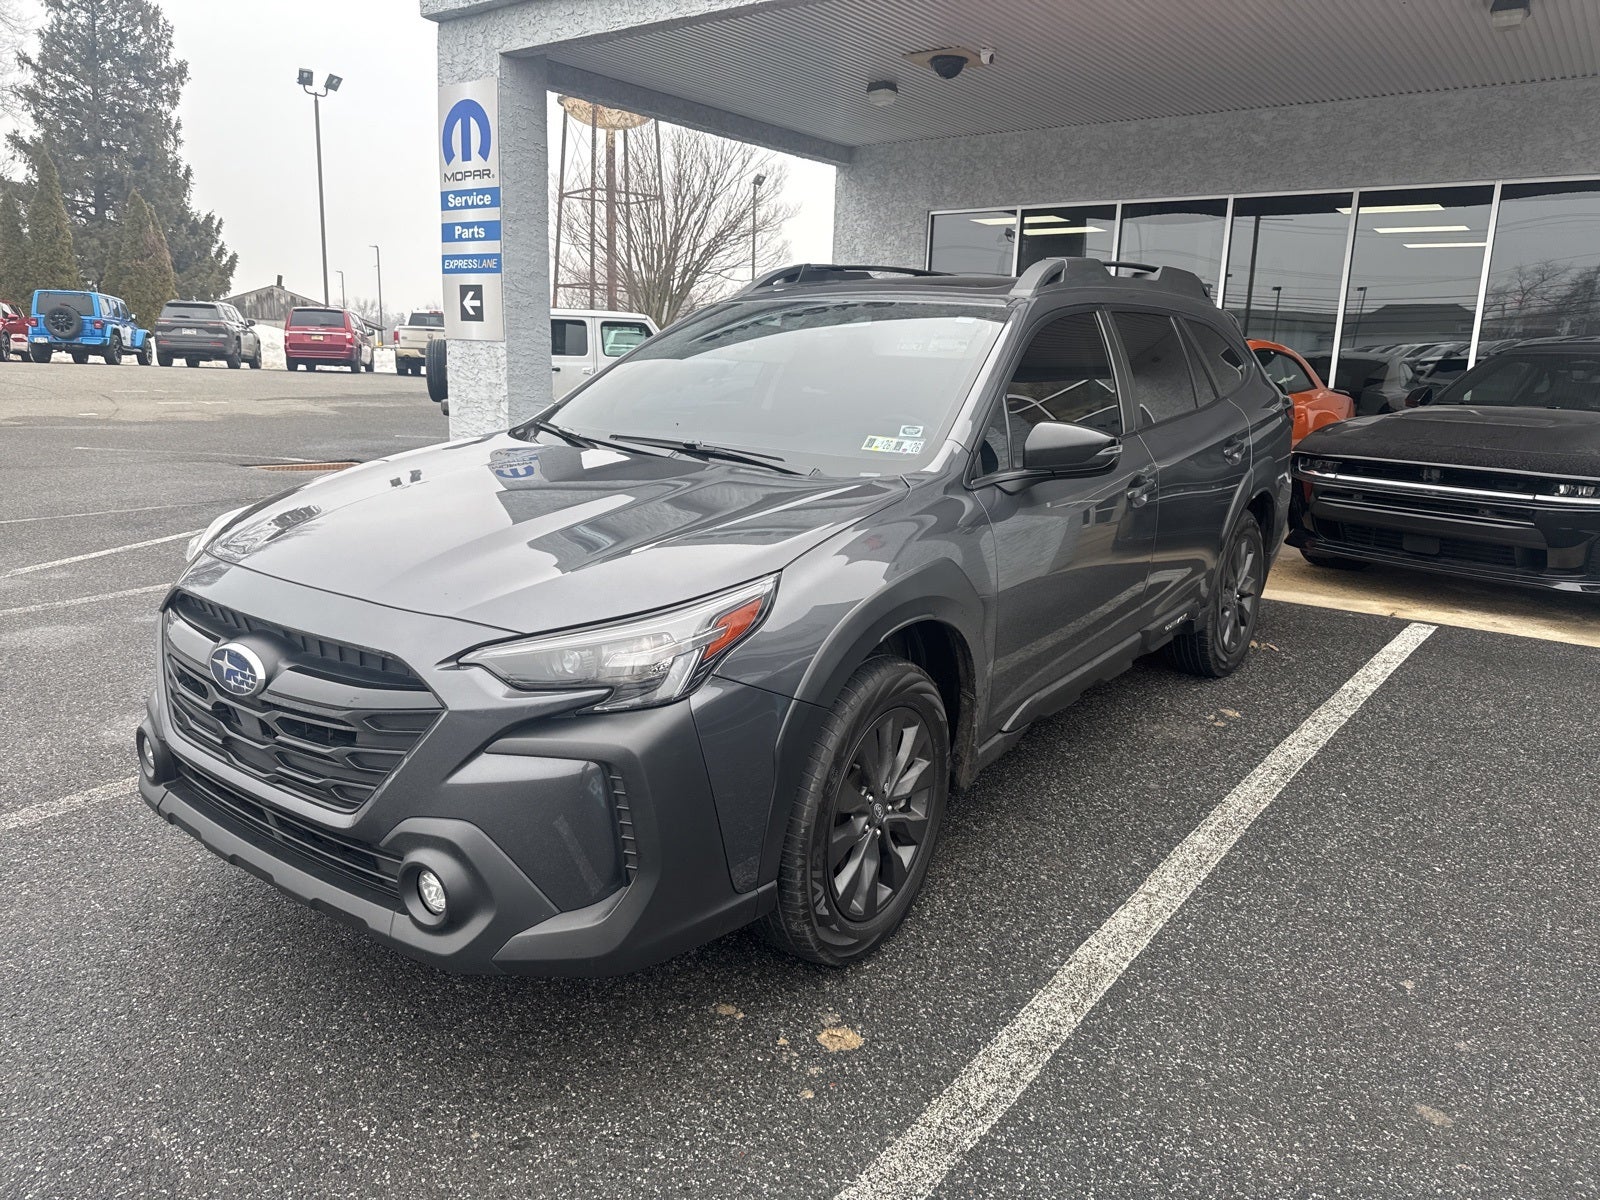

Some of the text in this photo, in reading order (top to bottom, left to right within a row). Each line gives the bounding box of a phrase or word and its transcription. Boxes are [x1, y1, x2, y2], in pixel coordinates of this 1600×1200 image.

[444, 168, 492, 183] MOPAR
[447, 192, 492, 207] Service
[454, 224, 485, 239] Parts
